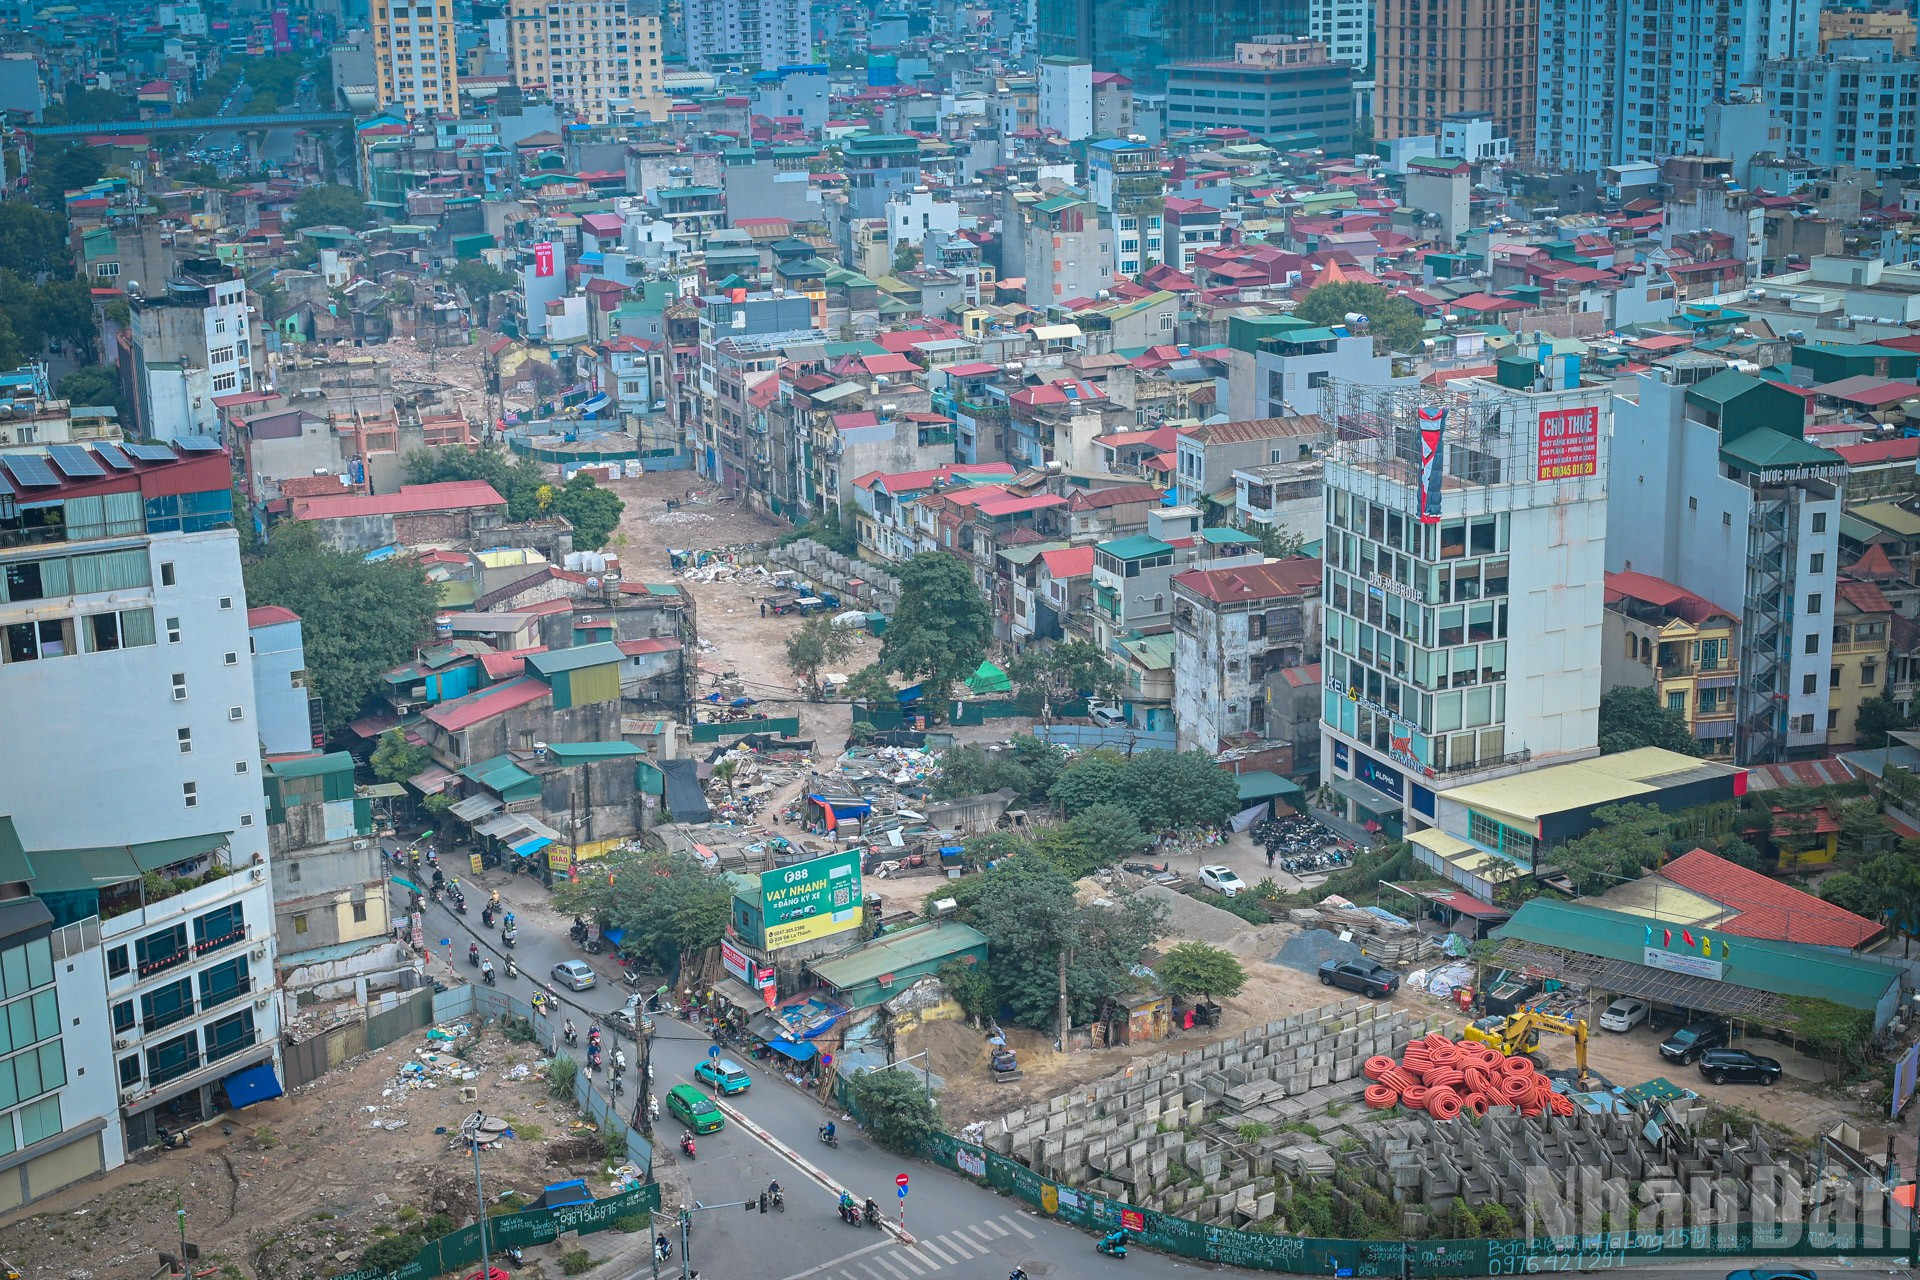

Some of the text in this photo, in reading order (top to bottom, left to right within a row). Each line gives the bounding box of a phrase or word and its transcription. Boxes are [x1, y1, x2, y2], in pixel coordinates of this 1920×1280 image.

[1544, 410, 1592, 437] CHO THUÊ
[1828, 463, 1849, 477] BÌNH
[1395, 581, 1423, 603] GROUP
[1389, 750, 1424, 774] GAMING
[1375, 771, 1395, 786] ALPHA
[766, 889, 786, 902] VAY
[790, 879, 827, 897] NHANH
[801, 894, 810, 902] KÝ
[811, 892, 821, 900] XE
